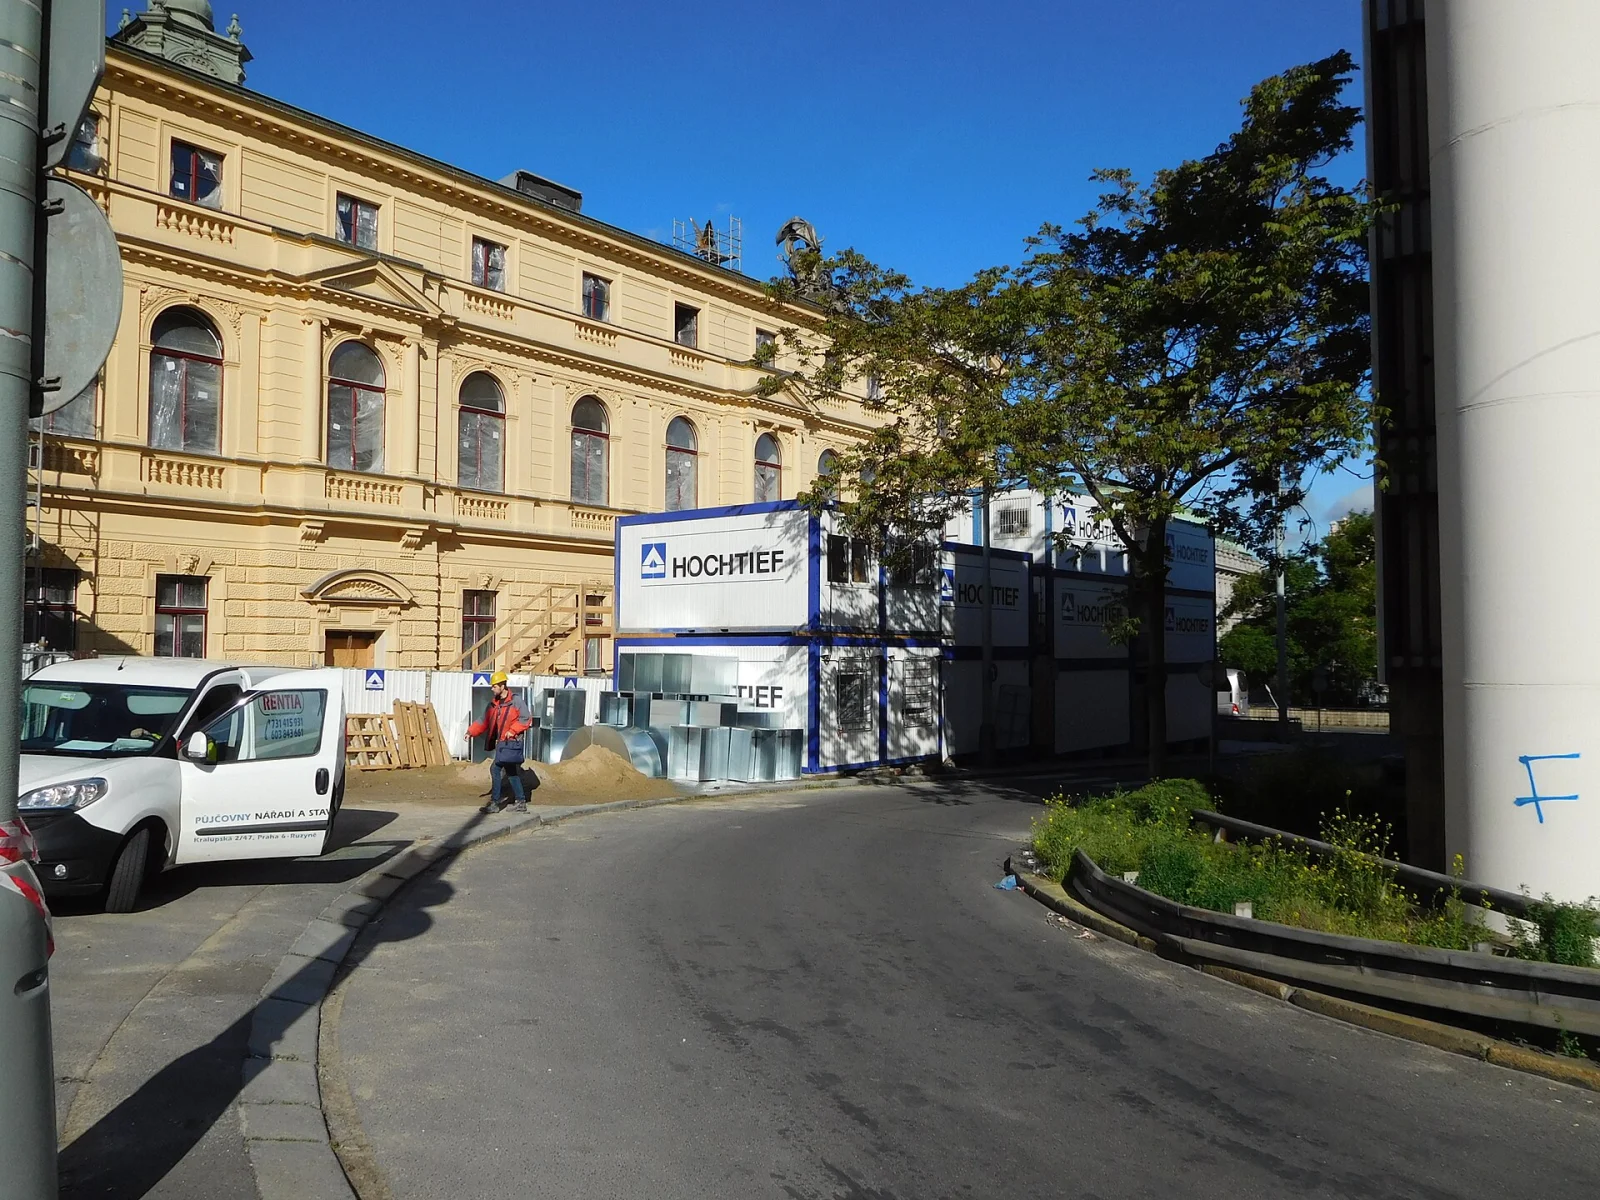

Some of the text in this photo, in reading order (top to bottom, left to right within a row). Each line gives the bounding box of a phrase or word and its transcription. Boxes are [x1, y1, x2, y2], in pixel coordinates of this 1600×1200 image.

[1078, 520, 1120, 543] HOCHTIE
[1176, 544, 1209, 563] HOCHTIEF
[672, 550, 784, 579] HOCHTIEF
[1175, 616, 1209, 633] HOCHTIEF
[262, 694, 302, 711] RENTIA
[732, 685, 783, 708] TIEF
[271, 719, 282, 729] 731
[283, 718, 293, 728] 415
